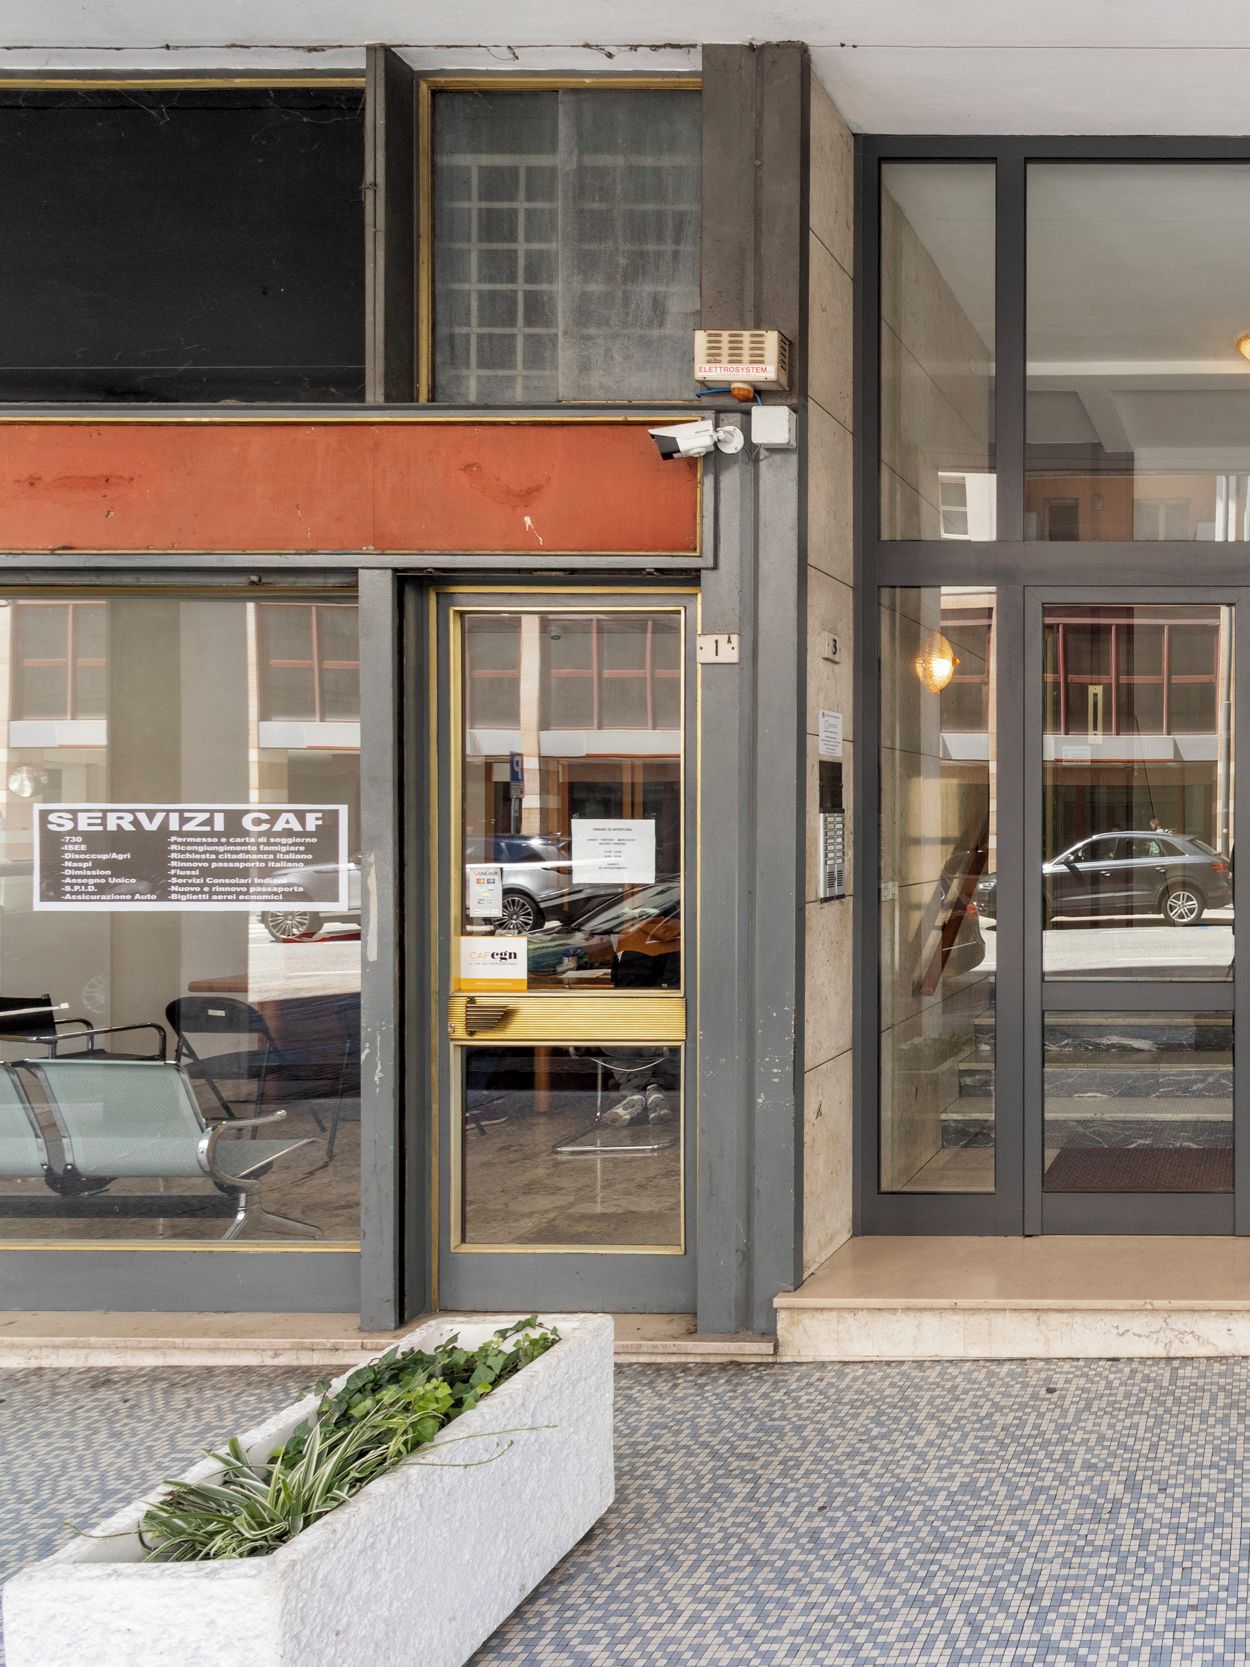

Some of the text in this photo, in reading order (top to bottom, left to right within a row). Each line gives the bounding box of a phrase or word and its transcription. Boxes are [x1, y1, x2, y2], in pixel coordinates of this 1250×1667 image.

[832, 638, 837, 655] 3
[46, 812, 323, 832] SERVIZI CAF
[269, 836, 318, 845] soggiorno
[168, 844, 258, 852] -Ricongiungimento
[61, 852, 131, 860] -Disoccup/Agri
[61, 877, 106, 885] -Assegno
[168, 893, 209, 901] -Biglietti
